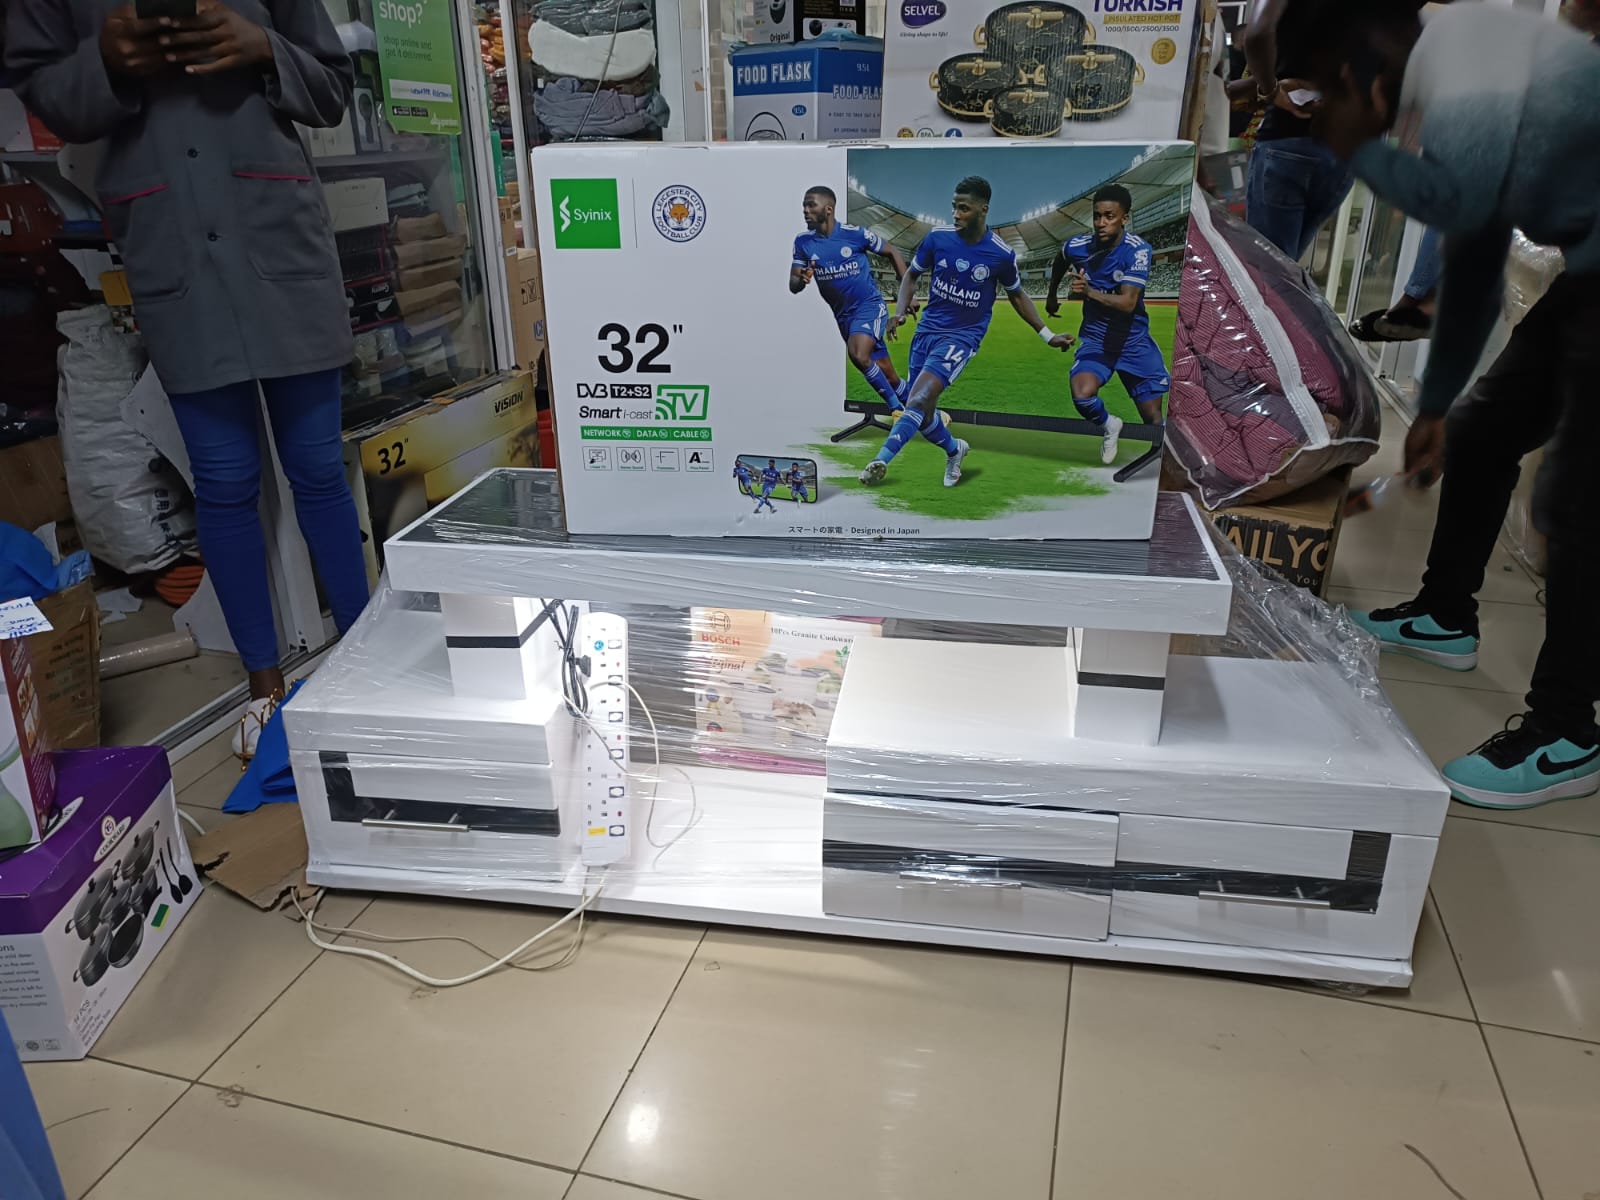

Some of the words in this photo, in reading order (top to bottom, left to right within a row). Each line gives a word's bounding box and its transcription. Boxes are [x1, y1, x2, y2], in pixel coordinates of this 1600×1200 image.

[904, 5, 941, 16] SELVEL
[1094, 0, 1183, 12] TURKISH
[380, 1, 423, 29] shop?
[770, 32, 790, 43] Original
[736, 65, 767, 85] FOOD
[771, 61, 812, 82] FLASK
[833, 84, 859, 100] FOOD
[656, 188, 690, 212] LEICESTER
[690, 194, 703, 212] CITY
[574, 208, 612, 224] Syinix
[656, 216, 690, 238] FOOTBALL
[689, 215, 703, 235] CLUB
[814, 261, 858, 276] THAILAND
[933, 276, 981, 300] THAILAND
[965, 300, 979, 308] YOU
[598, 322, 683, 374] 32"
[944, 344, 965, 363] 14
[576, 383, 608, 399] DVB
[612, 385, 650, 398] T2+S2
[579, 405, 622, 419] Smart
[666, 392, 699, 420] TV
[584, 428, 623, 437] NETWORK
[636, 429, 658, 438] DATA
[673, 430, 700, 438] CABLE
[377, 437, 409, 475] 32"
[851, 526, 886, 536] Designed
[897, 527, 920, 536] Japan
[701, 632, 741, 647] BOSCH
[791, 630, 817, 640] Granite
